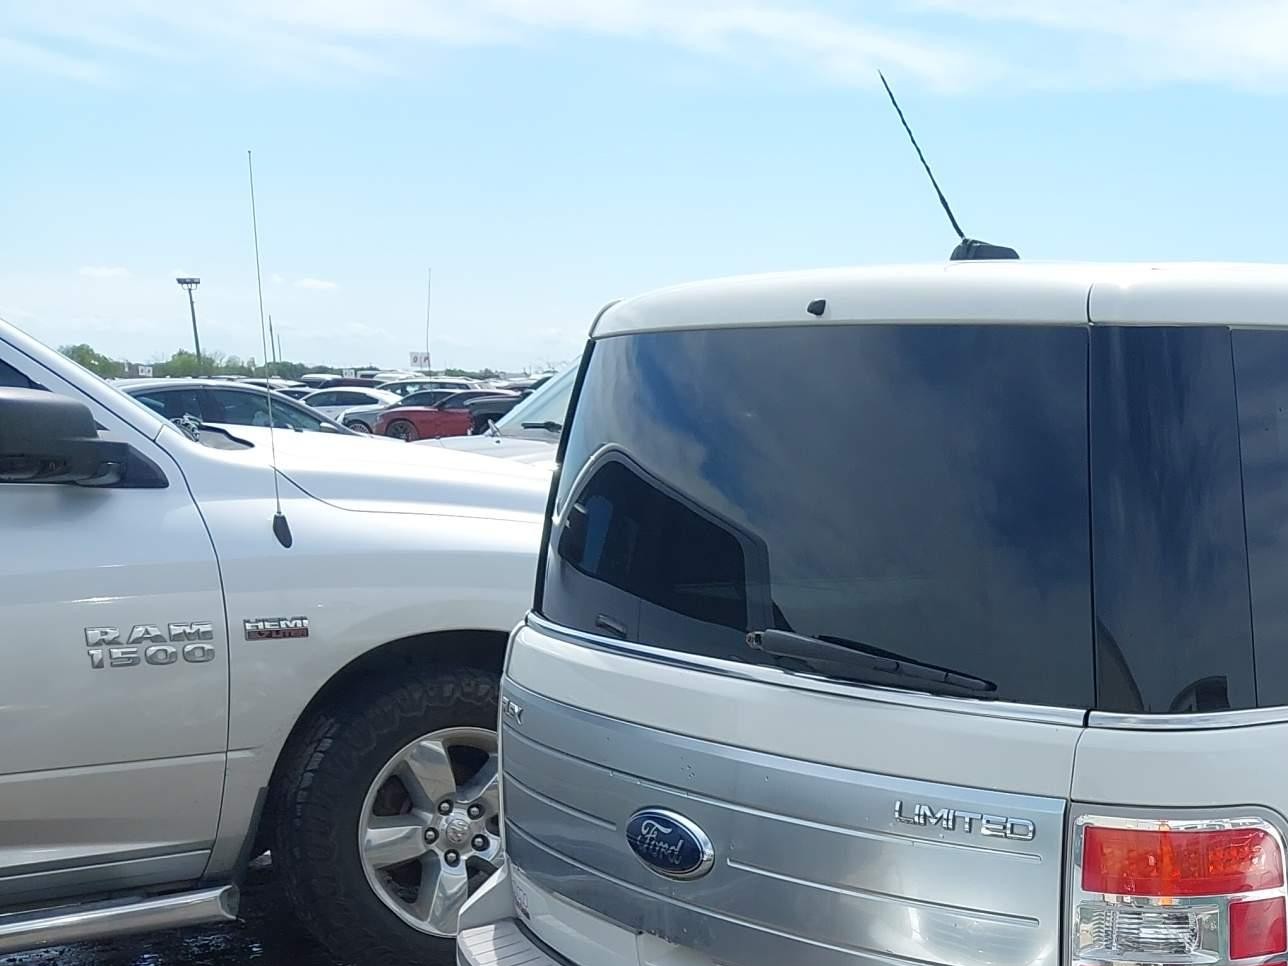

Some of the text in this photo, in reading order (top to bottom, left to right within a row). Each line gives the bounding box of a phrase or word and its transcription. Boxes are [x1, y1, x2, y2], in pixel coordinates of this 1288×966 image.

[84, 621, 213, 646] RAM
[243, 616, 309, 630] HEMI
[88, 643, 215, 669] 1500
[894, 800, 1036, 842] LIMITED
[636, 819, 685, 865] Ford
